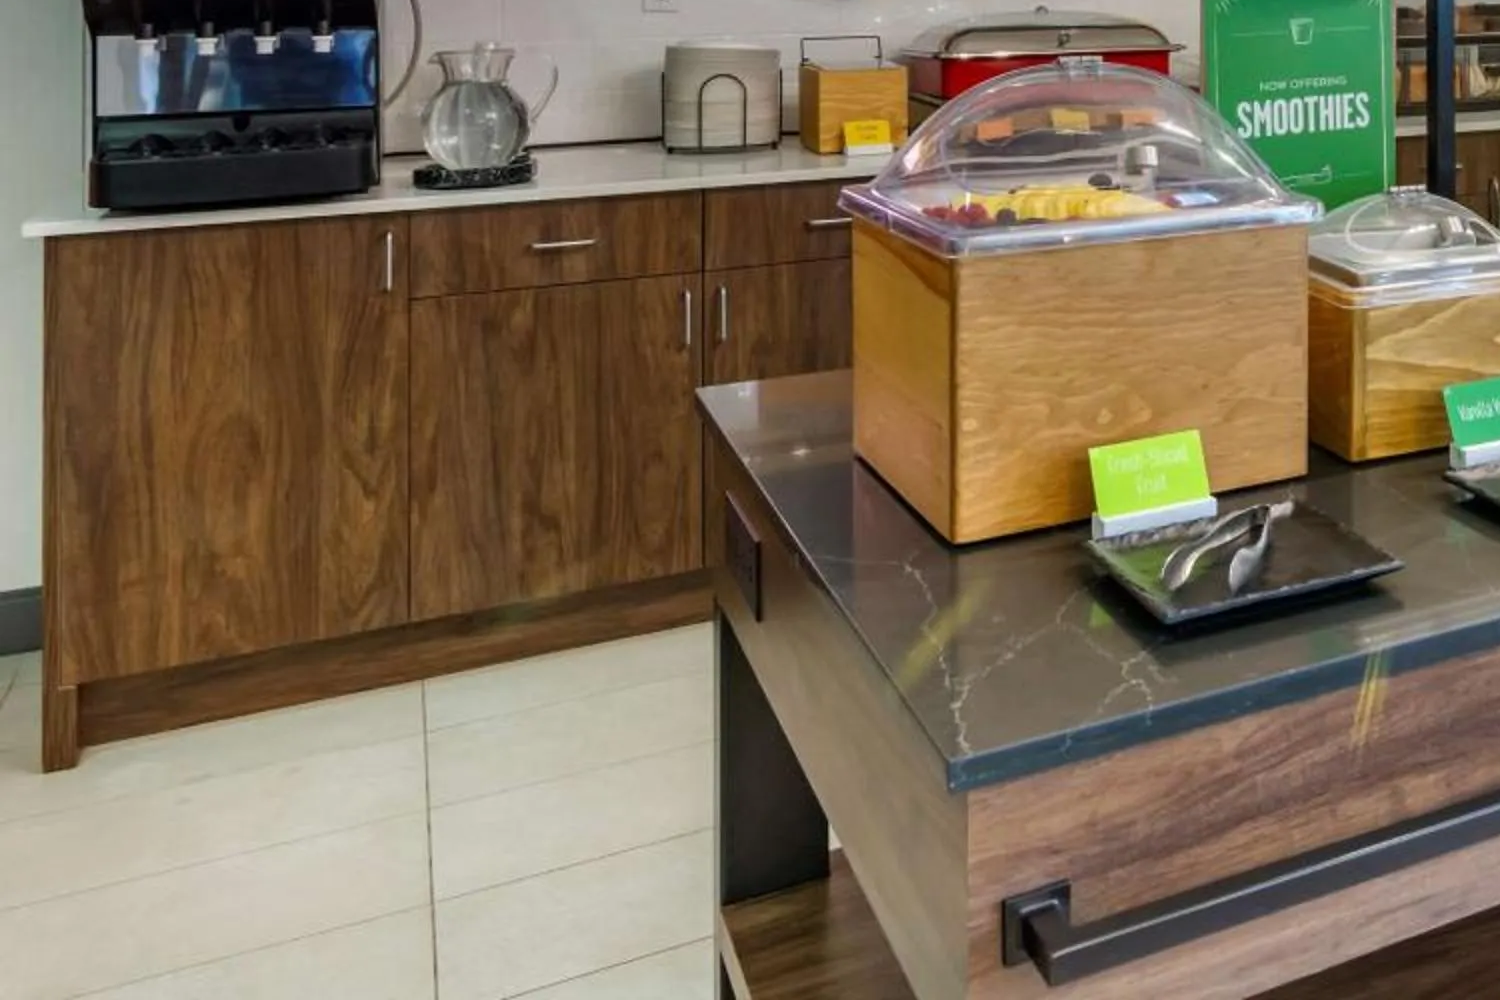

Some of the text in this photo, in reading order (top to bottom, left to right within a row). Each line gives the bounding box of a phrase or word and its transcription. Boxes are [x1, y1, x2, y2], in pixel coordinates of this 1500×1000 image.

[1259, 75, 1348, 92] NOW OFFERING
[1237, 92, 1370, 139] SMOOTHIES
